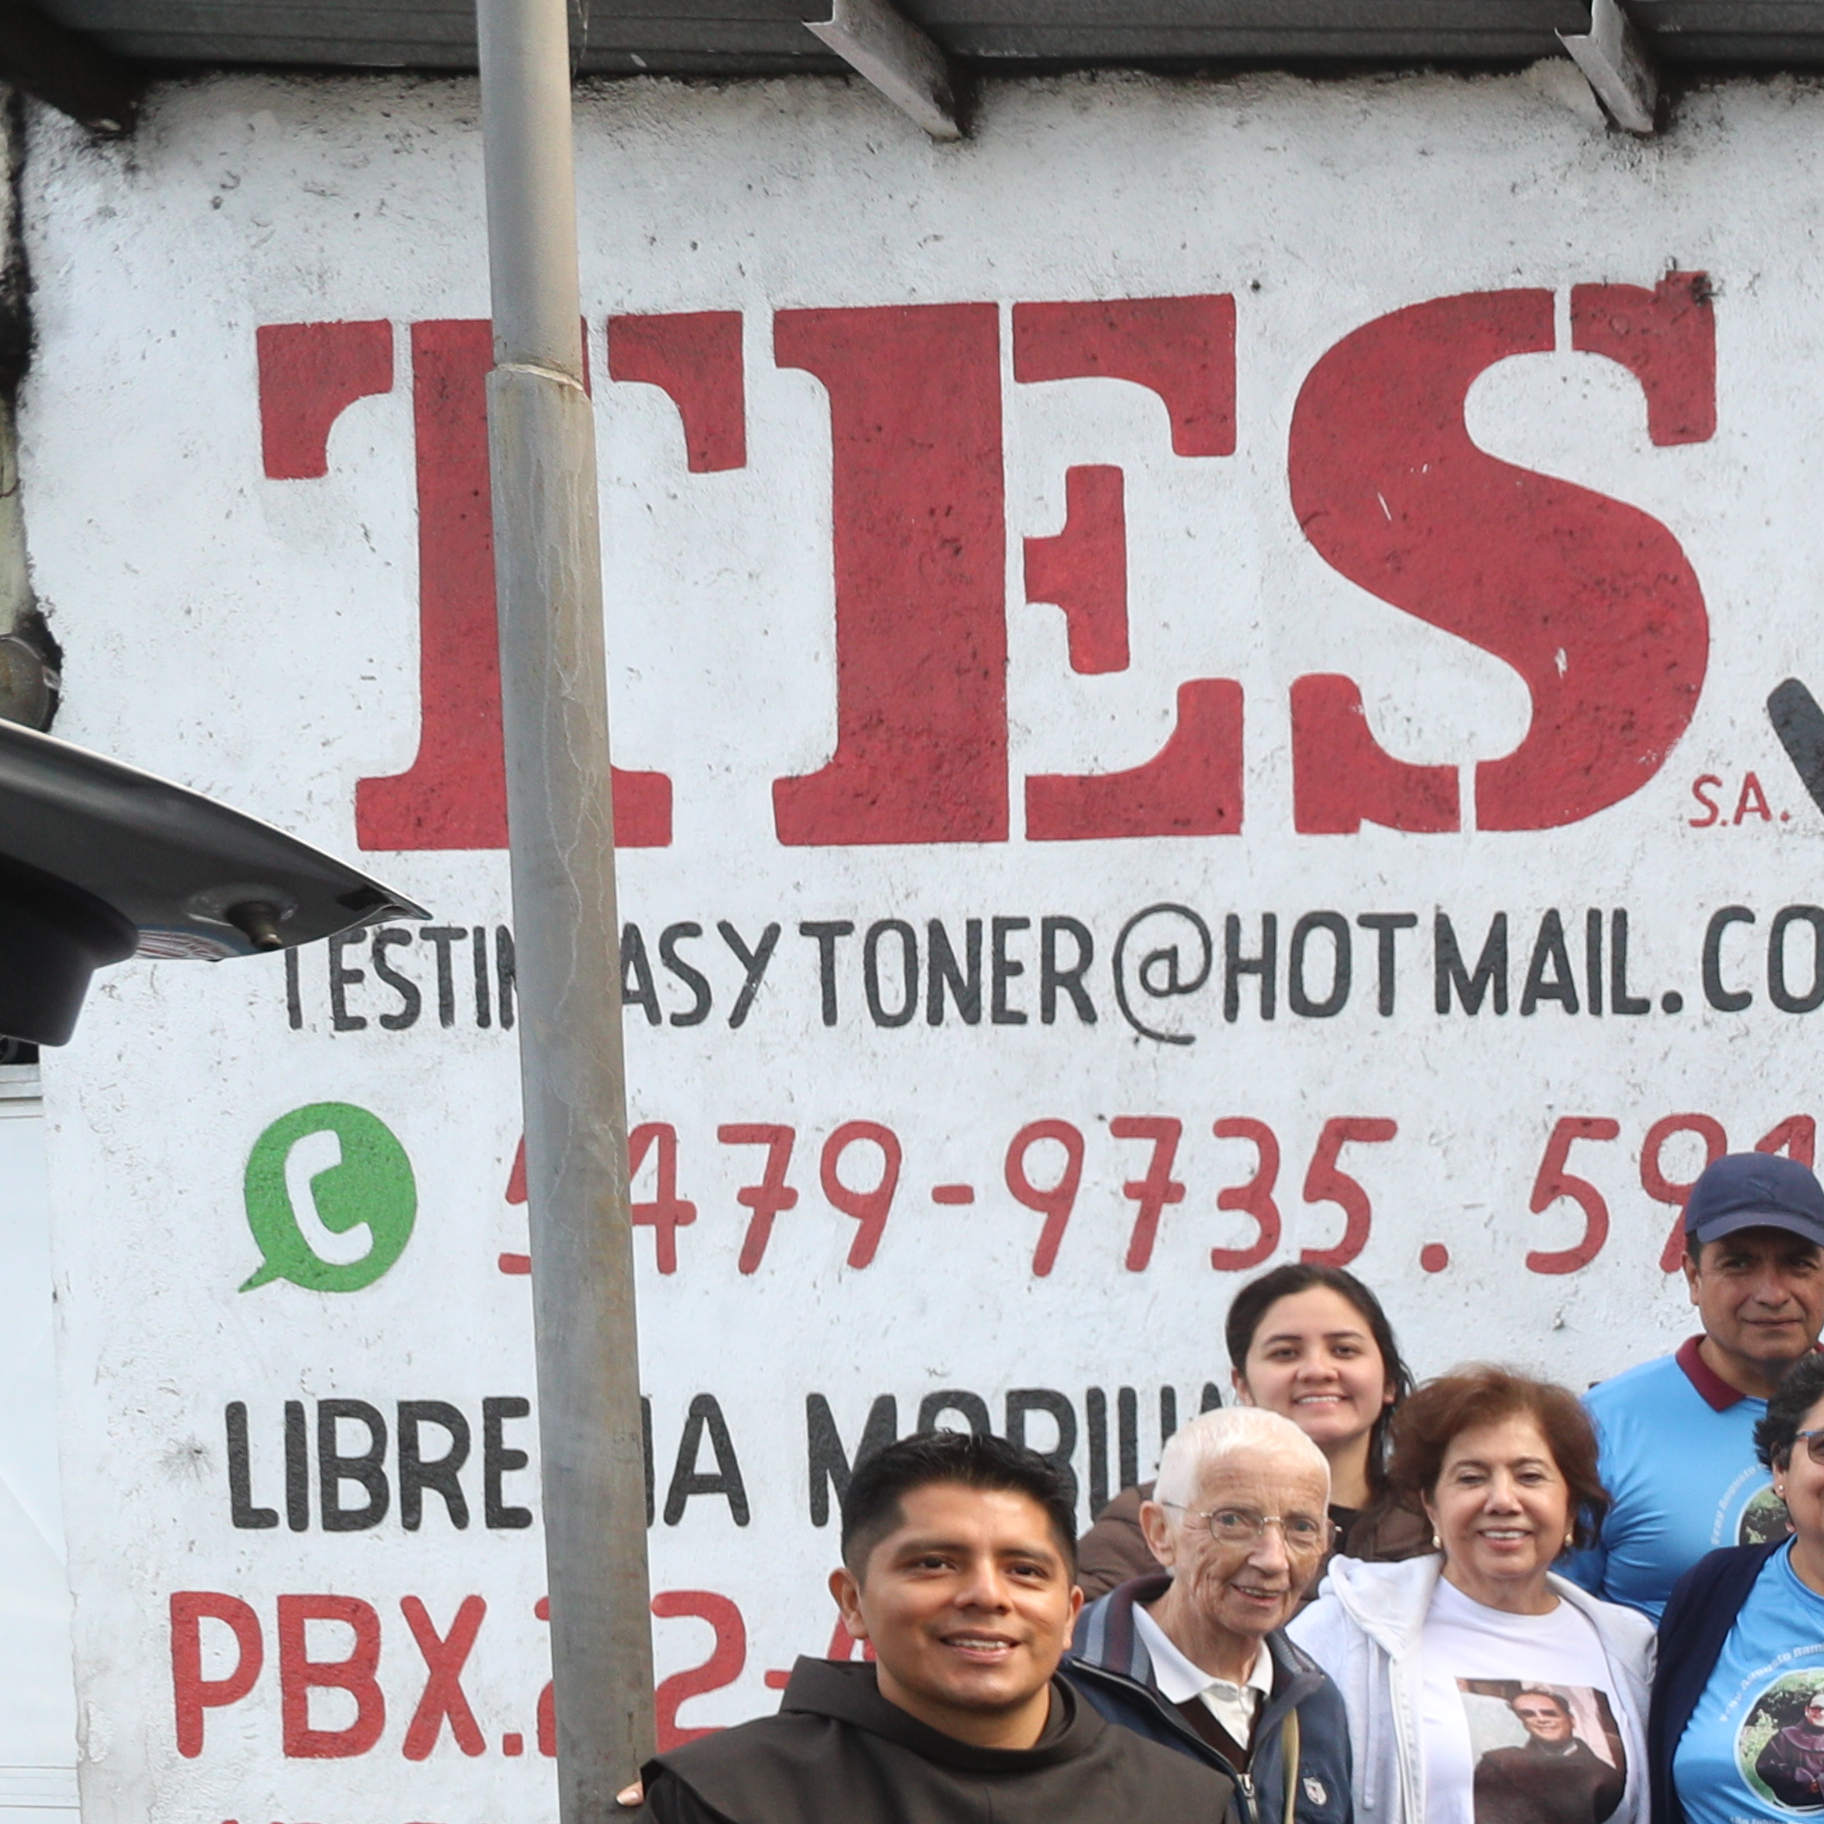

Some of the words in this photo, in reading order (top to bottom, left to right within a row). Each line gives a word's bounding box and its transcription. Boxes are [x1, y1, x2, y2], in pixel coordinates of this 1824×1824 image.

[255, 268, 1718, 852] TES
[1688, 771, 1791, 828] S.A.
[224, 1392, 751, 1533] LIBREA
